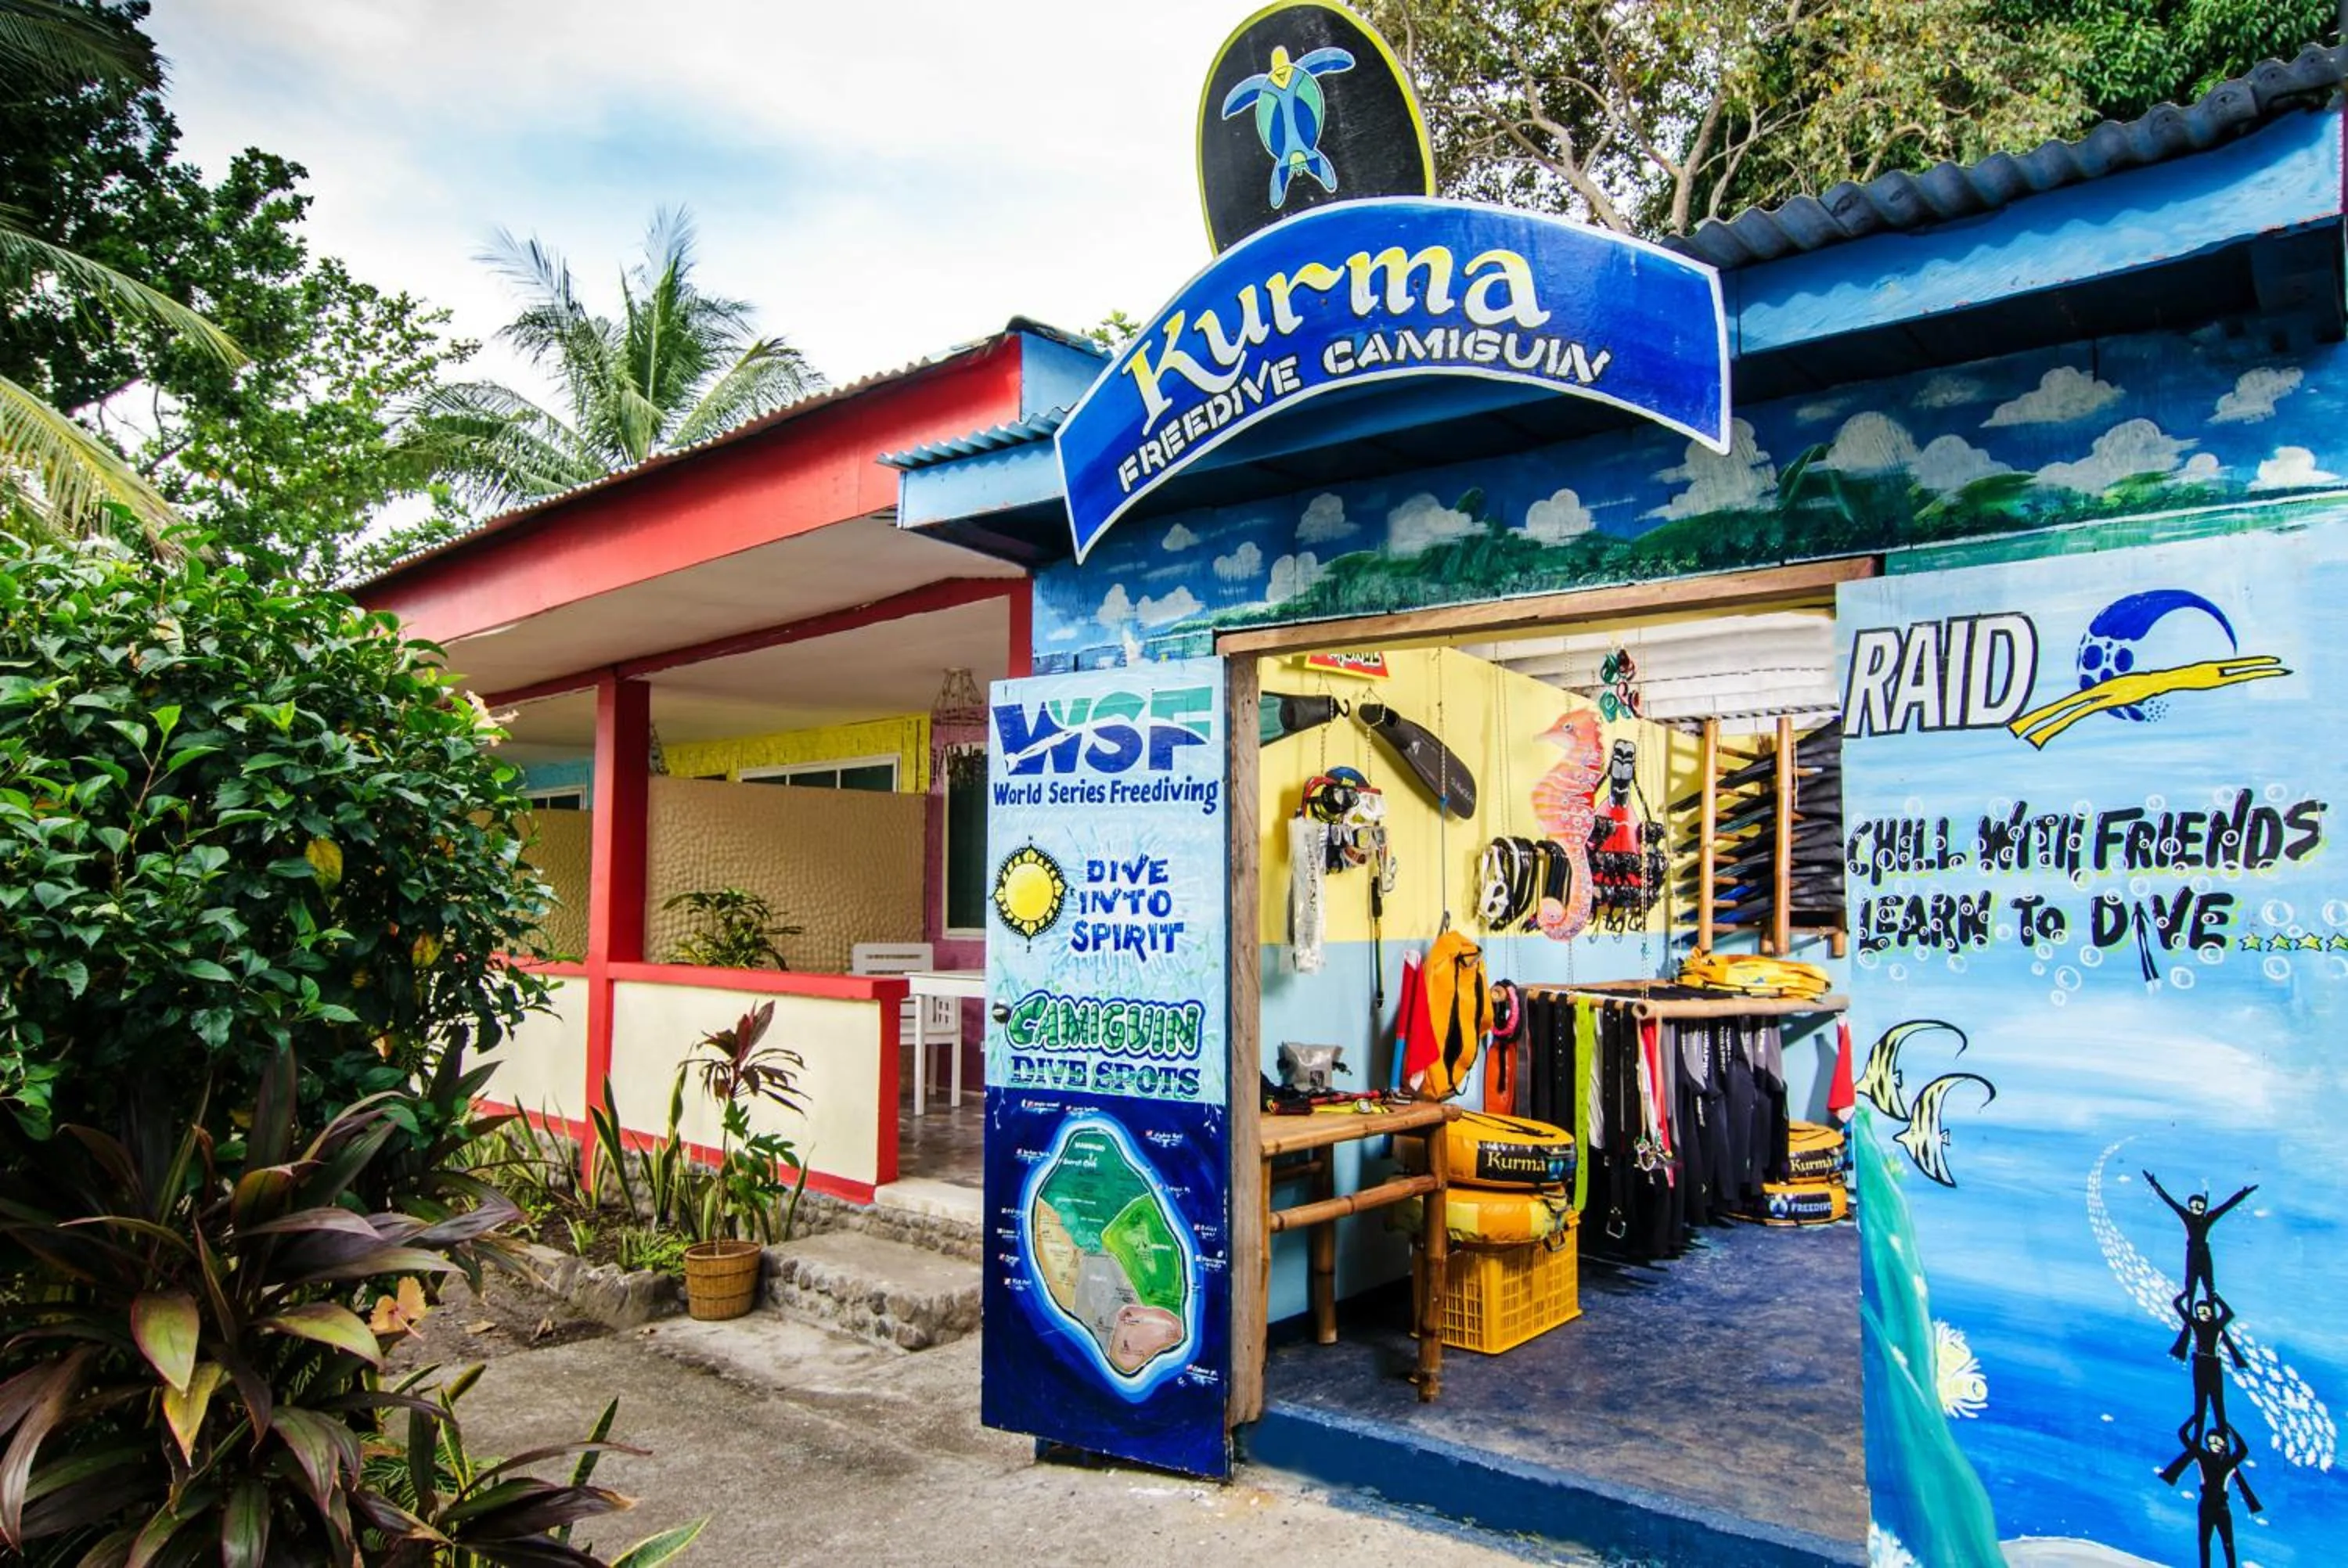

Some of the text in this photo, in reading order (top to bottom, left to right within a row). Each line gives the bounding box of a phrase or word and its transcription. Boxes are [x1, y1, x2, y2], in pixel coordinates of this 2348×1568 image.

[1122, 245, 1550, 434] Kurma
[1118, 327, 1612, 493] FREEDIVE CAMIGUIN
[1843, 612, 2037, 738] RAID
[992, 686, 1213, 775] WSF
[993, 776, 1219, 815] World Series Freediving
[1846, 789, 2328, 889] CHILL WITH FRIENDS
[1087, 853, 1169, 885] DIVE
[1079, 887, 1172, 918] INTO
[1071, 920, 1184, 963] SPIRIT
[1859, 890, 1992, 954] LEARN
[2091, 886, 2236, 981] DIVE
[1007, 991, 1203, 1059] CAMIGUIN
[1011, 1056, 1201, 1095] DIVE SPOTS
[1487, 1151, 1547, 1171] Kurma
[1790, 1157, 1833, 1172] Kurma
